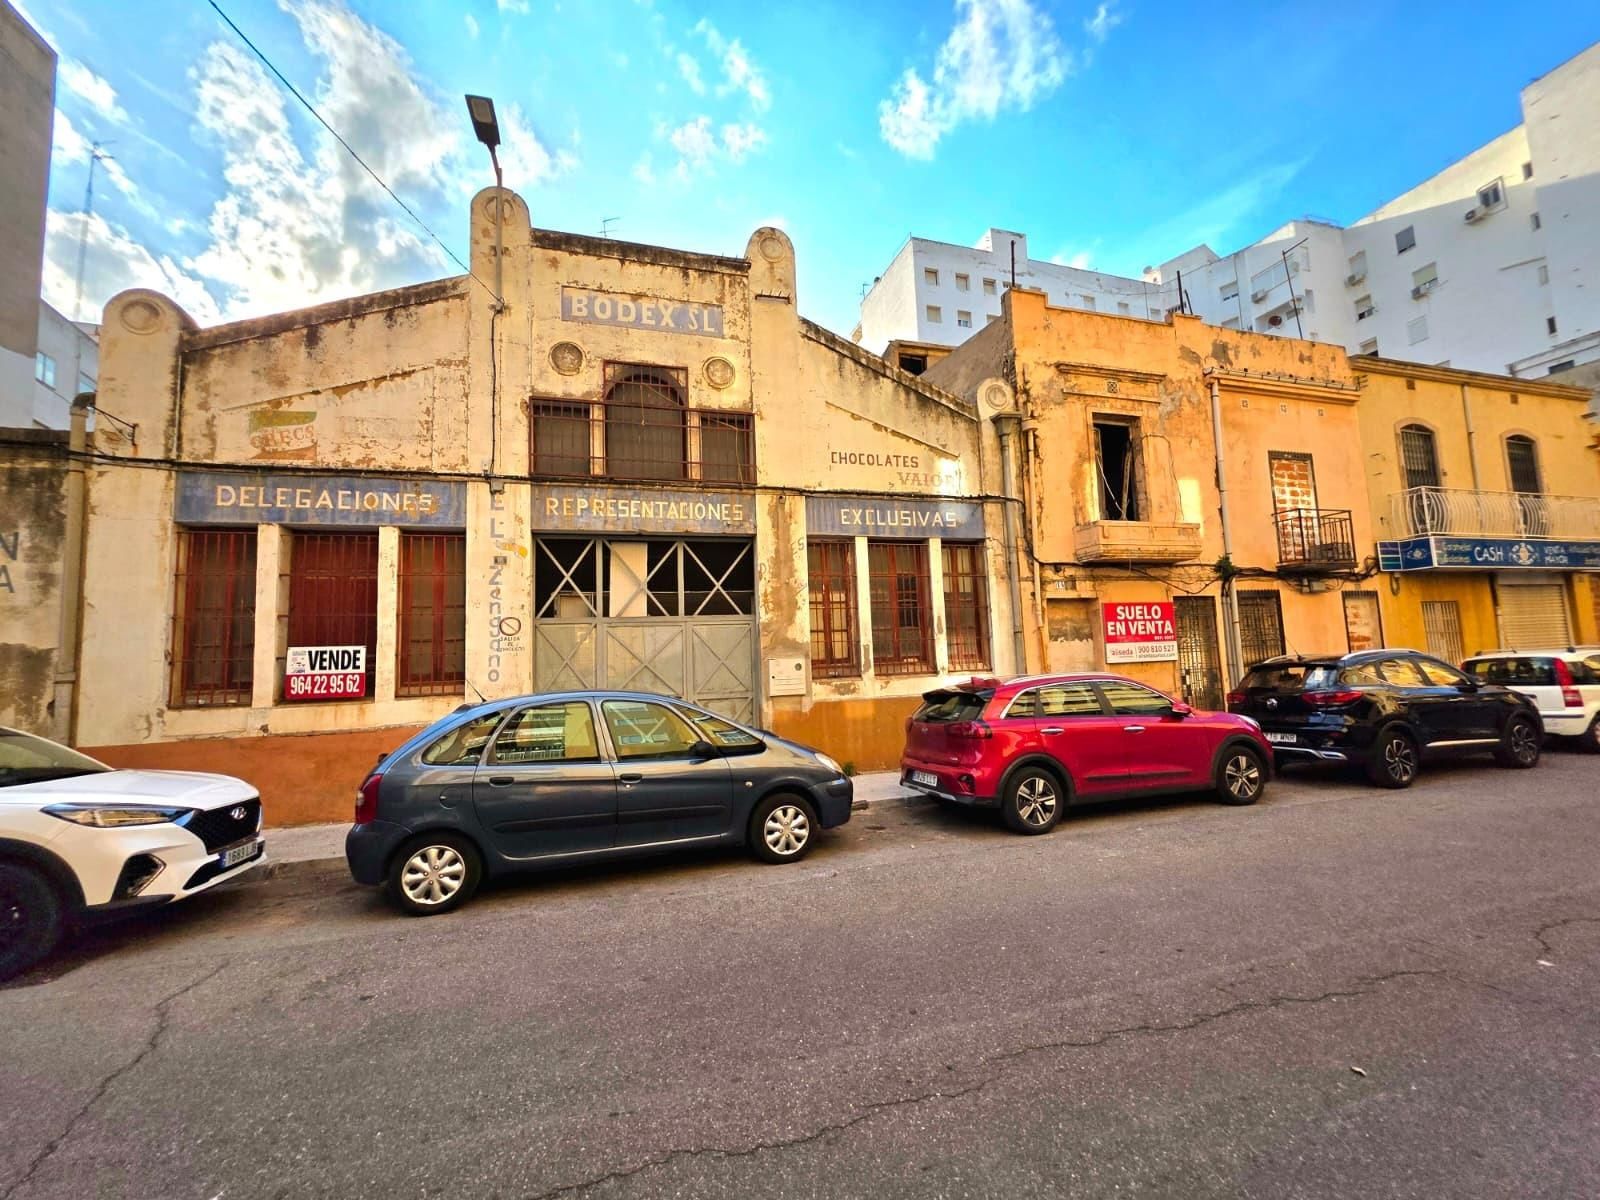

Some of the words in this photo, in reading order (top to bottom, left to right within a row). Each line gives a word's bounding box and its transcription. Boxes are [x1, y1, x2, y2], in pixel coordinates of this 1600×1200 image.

[571, 295, 675, 328] BODEX
[831, 451, 919, 468] CHOCOLATES
[215, 485, 433, 511] DELEGACIONES
[545, 497, 744, 521] REPRESENTACIONES
[840, 508, 957, 528] EXCLUSIVAS
[1473, 546, 1504, 562] CASH
[1116, 605, 1162, 620] SUELO
[1107, 621, 1126, 636] EN
[1128, 620, 1174, 635] VENTA
[1137, 645, 1150, 654] 900
[308, 649, 361, 671] VENDE
[290, 675, 312, 695] 964
[313, 675, 328, 694] 22
[330, 674, 344, 693] 95
[346, 674, 360, 693] 62
